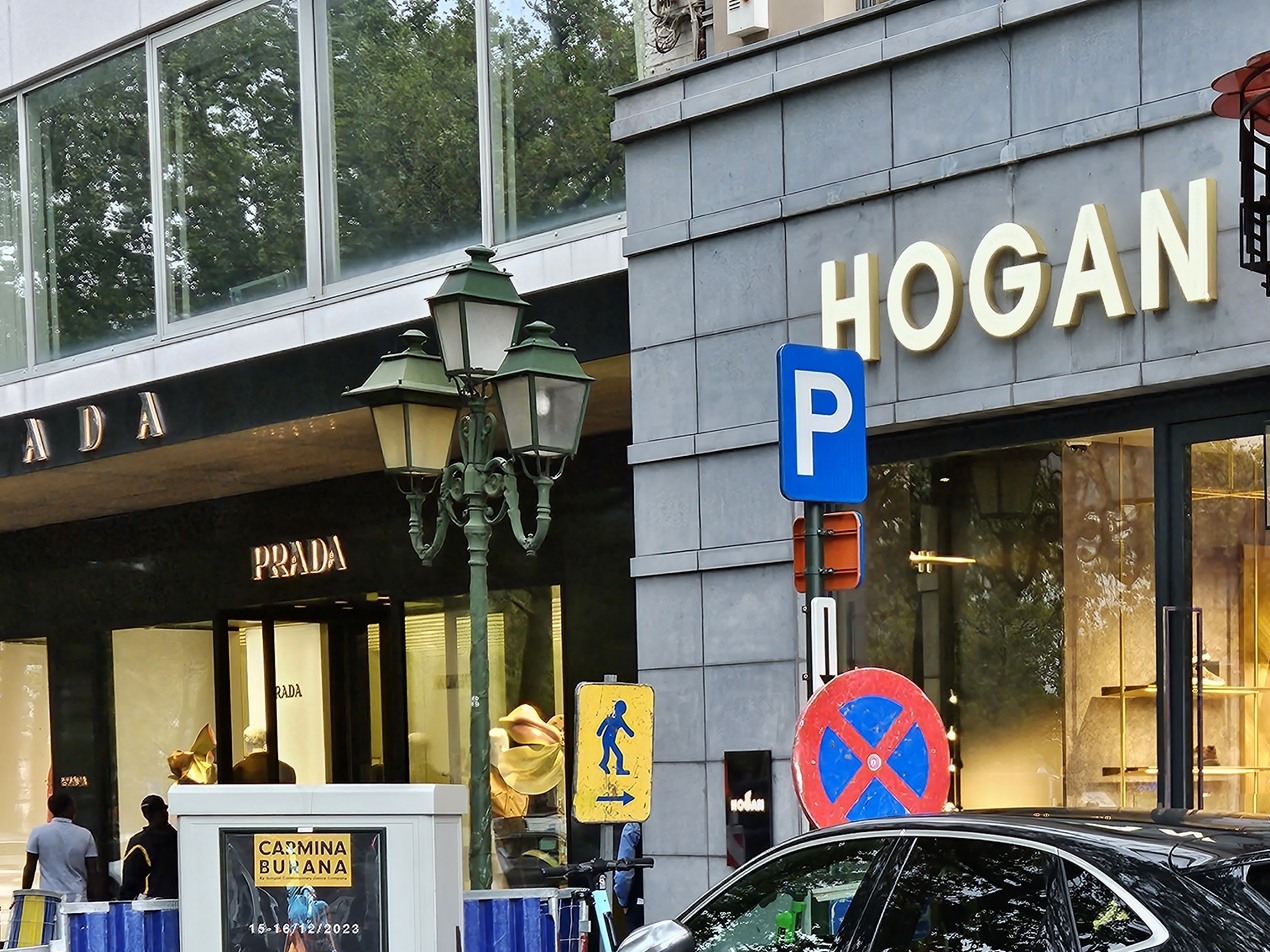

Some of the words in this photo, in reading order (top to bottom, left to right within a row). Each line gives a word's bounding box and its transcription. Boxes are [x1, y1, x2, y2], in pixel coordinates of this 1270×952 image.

[821, 177, 1217, 362] HOGAN
[794, 369, 853, 476] P
[252, 535, 348, 581] PRADA
[259, 840, 347, 856] CARMINA
[259, 859, 348, 874] BURANA
[249, 923, 360, 935] 15-16/12/2023
